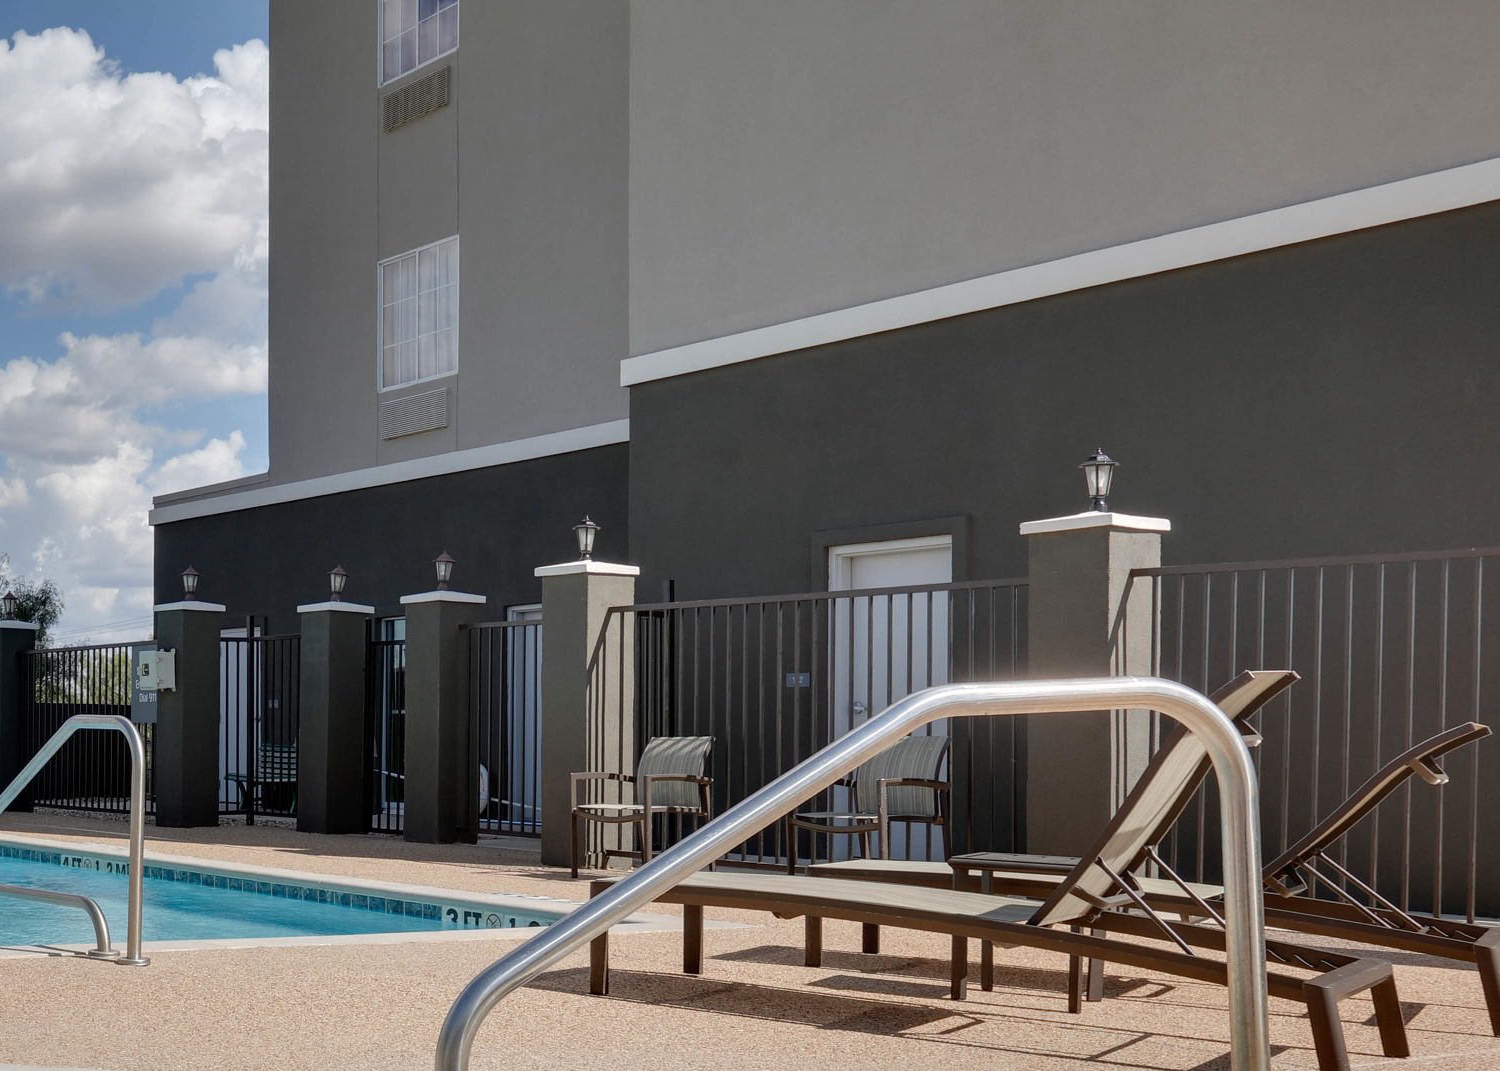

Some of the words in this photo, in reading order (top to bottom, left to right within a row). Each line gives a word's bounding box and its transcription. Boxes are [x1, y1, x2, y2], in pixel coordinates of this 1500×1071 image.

[149, 692, 157, 703] 911
[72, 857, 81, 868] FT
[463, 910, 482, 926] FT
